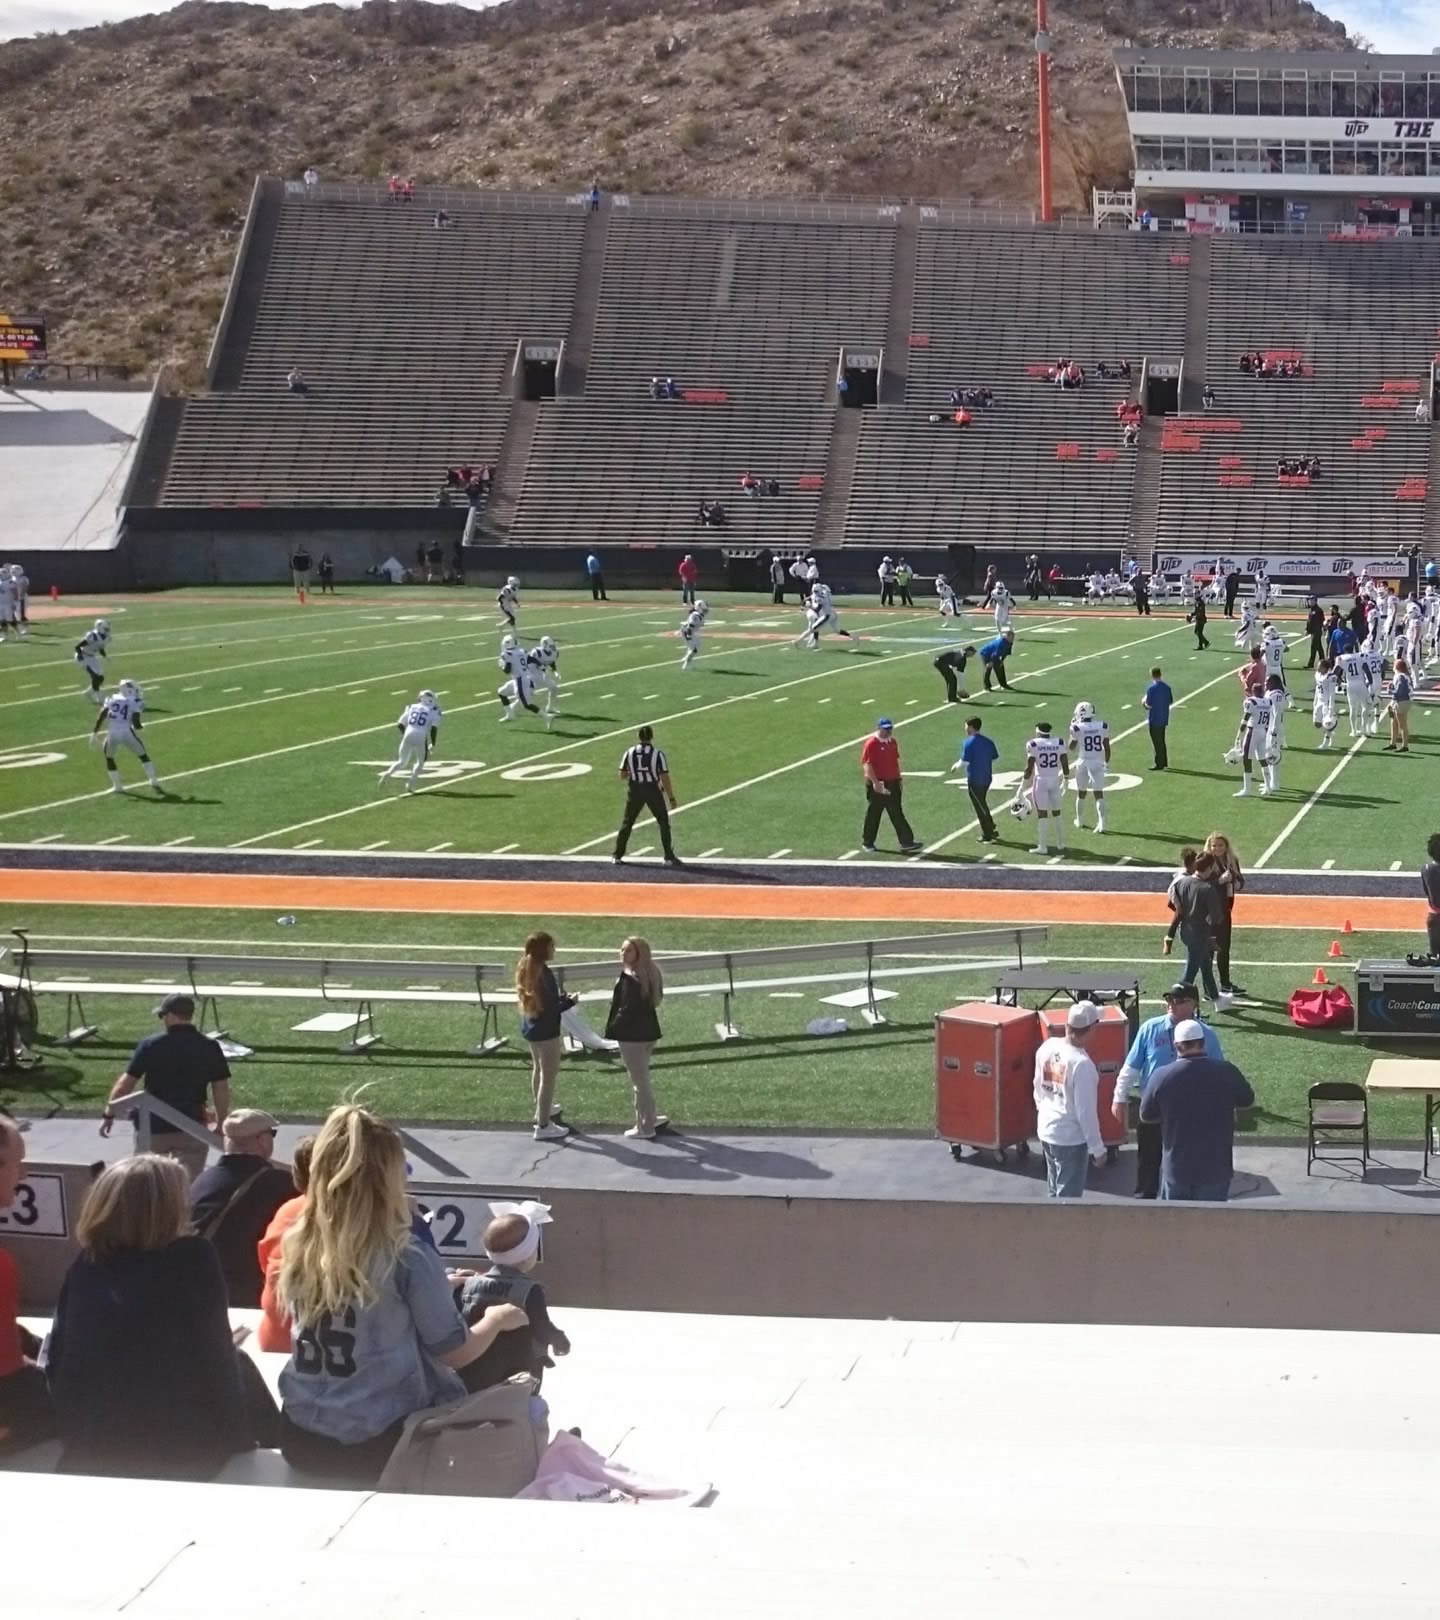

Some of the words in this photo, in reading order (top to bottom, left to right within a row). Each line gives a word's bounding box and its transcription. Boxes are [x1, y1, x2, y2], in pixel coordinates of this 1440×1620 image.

[1344, 119, 1369, 137] UTEP
[1394, 121, 1434, 138] THE
[1160, 556, 1183, 572] UTEP
[1246, 557, 1269, 573] UTEP
[1332, 558, 1354, 574] UTEP
[1274, 649, 1281, 661] 8
[1347, 662, 1359, 677] 41
[1371, 660, 1382, 674] 23
[110, 704, 129, 720] 24
[409, 711, 429, 727] 86
[1084, 735, 1103, 752] 89
[636, 754, 649, 771] L
[1039, 753, 1058, 768] 32
[0, 1184, 39, 1226] 3
